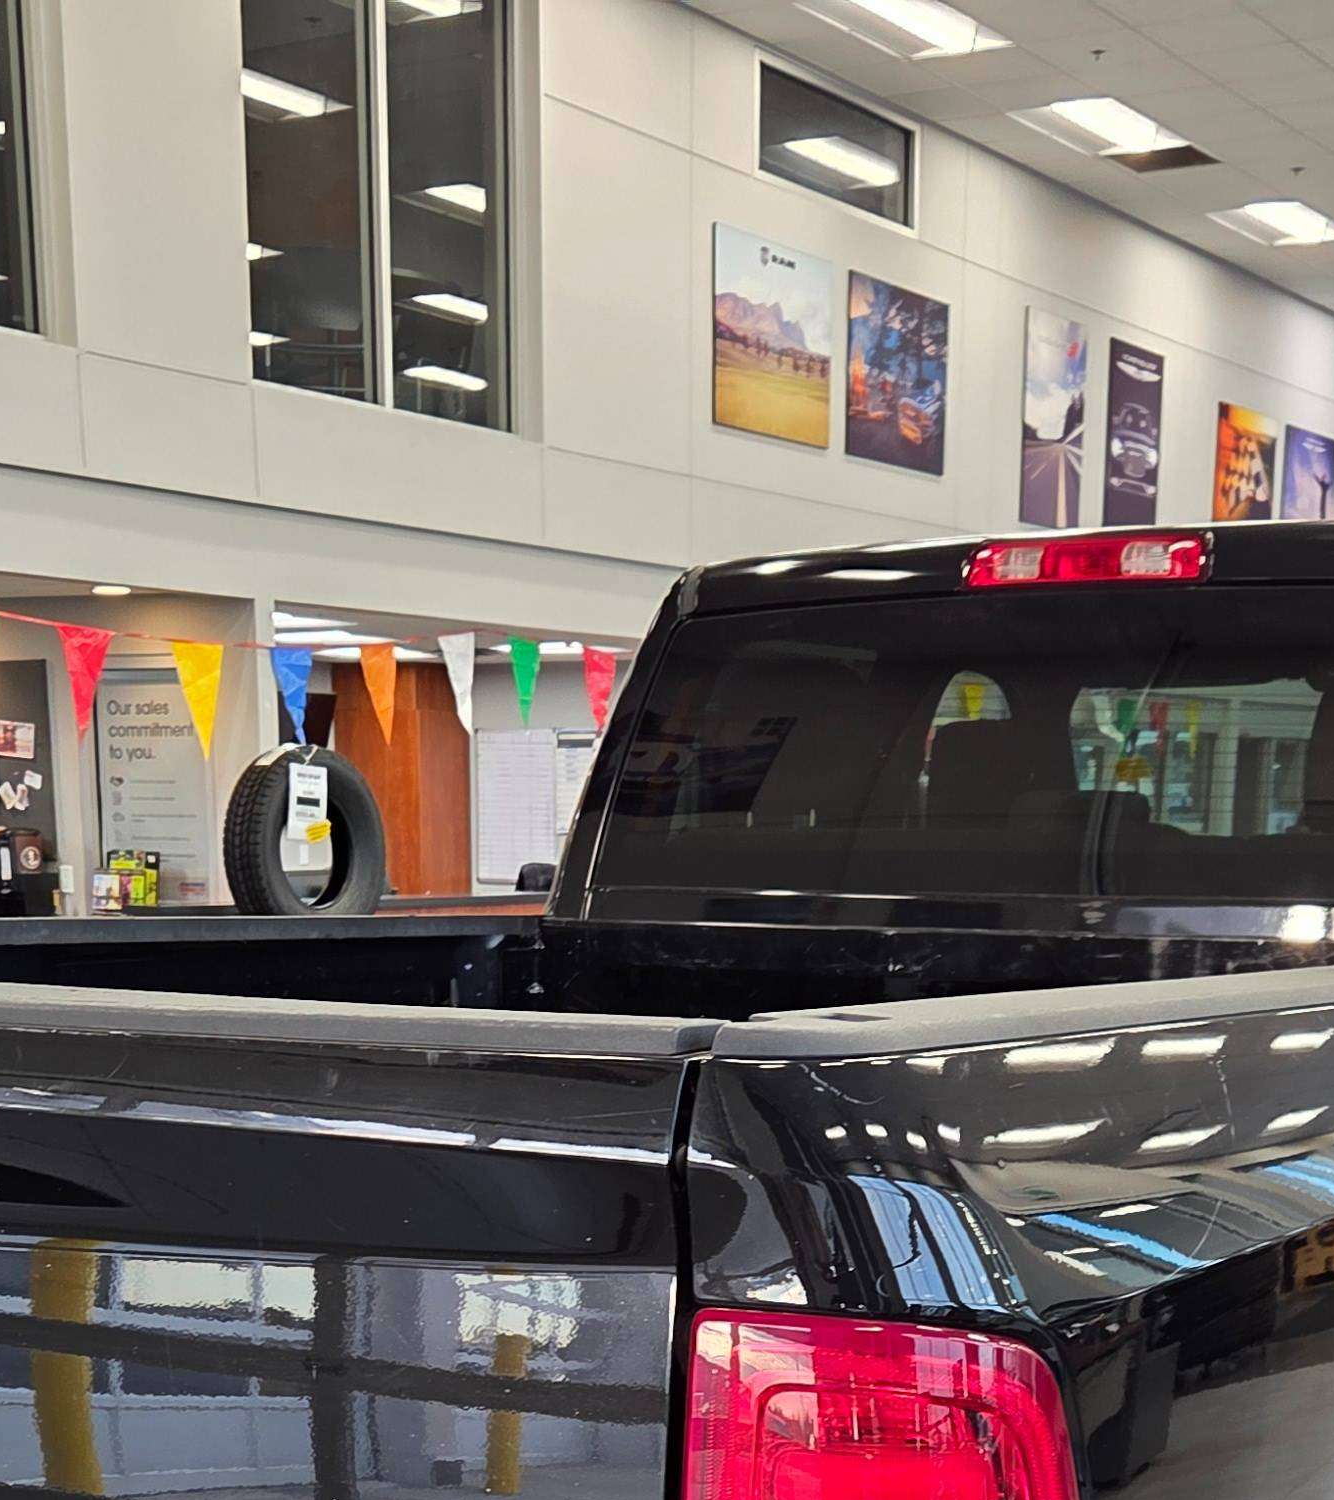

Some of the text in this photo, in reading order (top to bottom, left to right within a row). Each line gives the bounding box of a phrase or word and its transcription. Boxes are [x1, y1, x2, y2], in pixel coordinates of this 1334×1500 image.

[107, 700, 169, 716] Our sales
[108, 722, 195, 738] commitment
[109, 745, 156, 763] to you.
